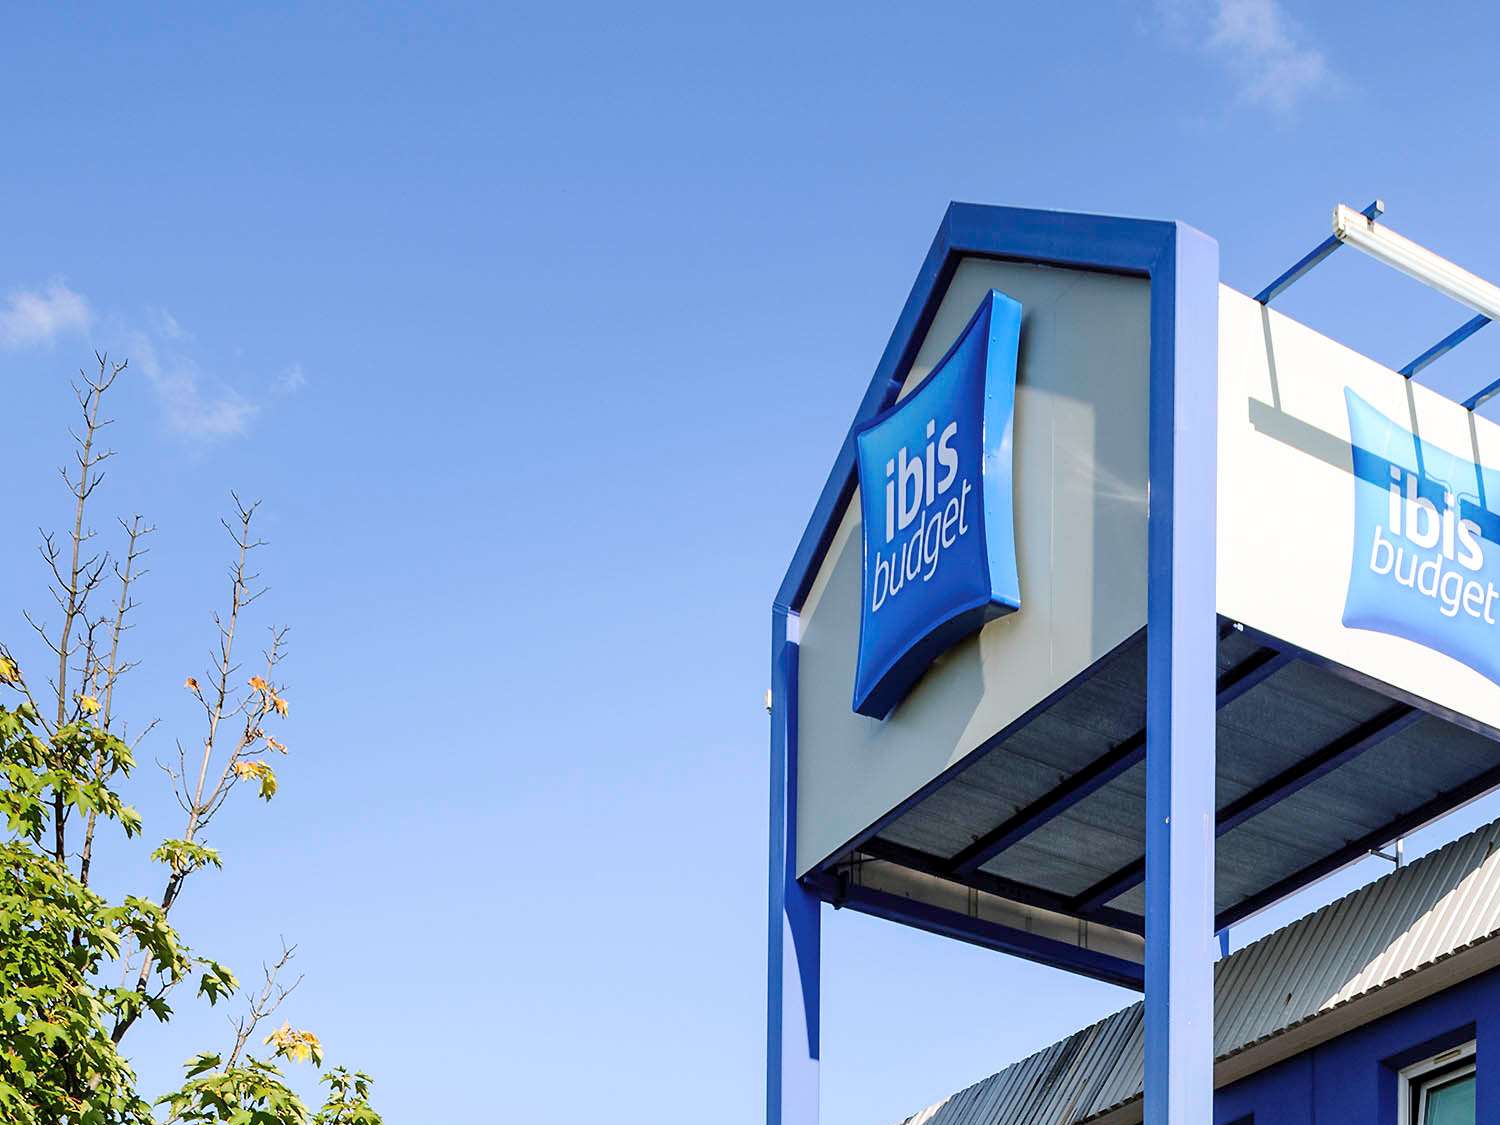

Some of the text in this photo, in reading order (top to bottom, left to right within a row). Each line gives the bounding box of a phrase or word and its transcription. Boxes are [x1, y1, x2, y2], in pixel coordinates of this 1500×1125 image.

[886, 418, 958, 543] ibis
[1389, 464, 1484, 571] ibis
[872, 479, 971, 612] budget
[1370, 525, 1499, 625] budget
